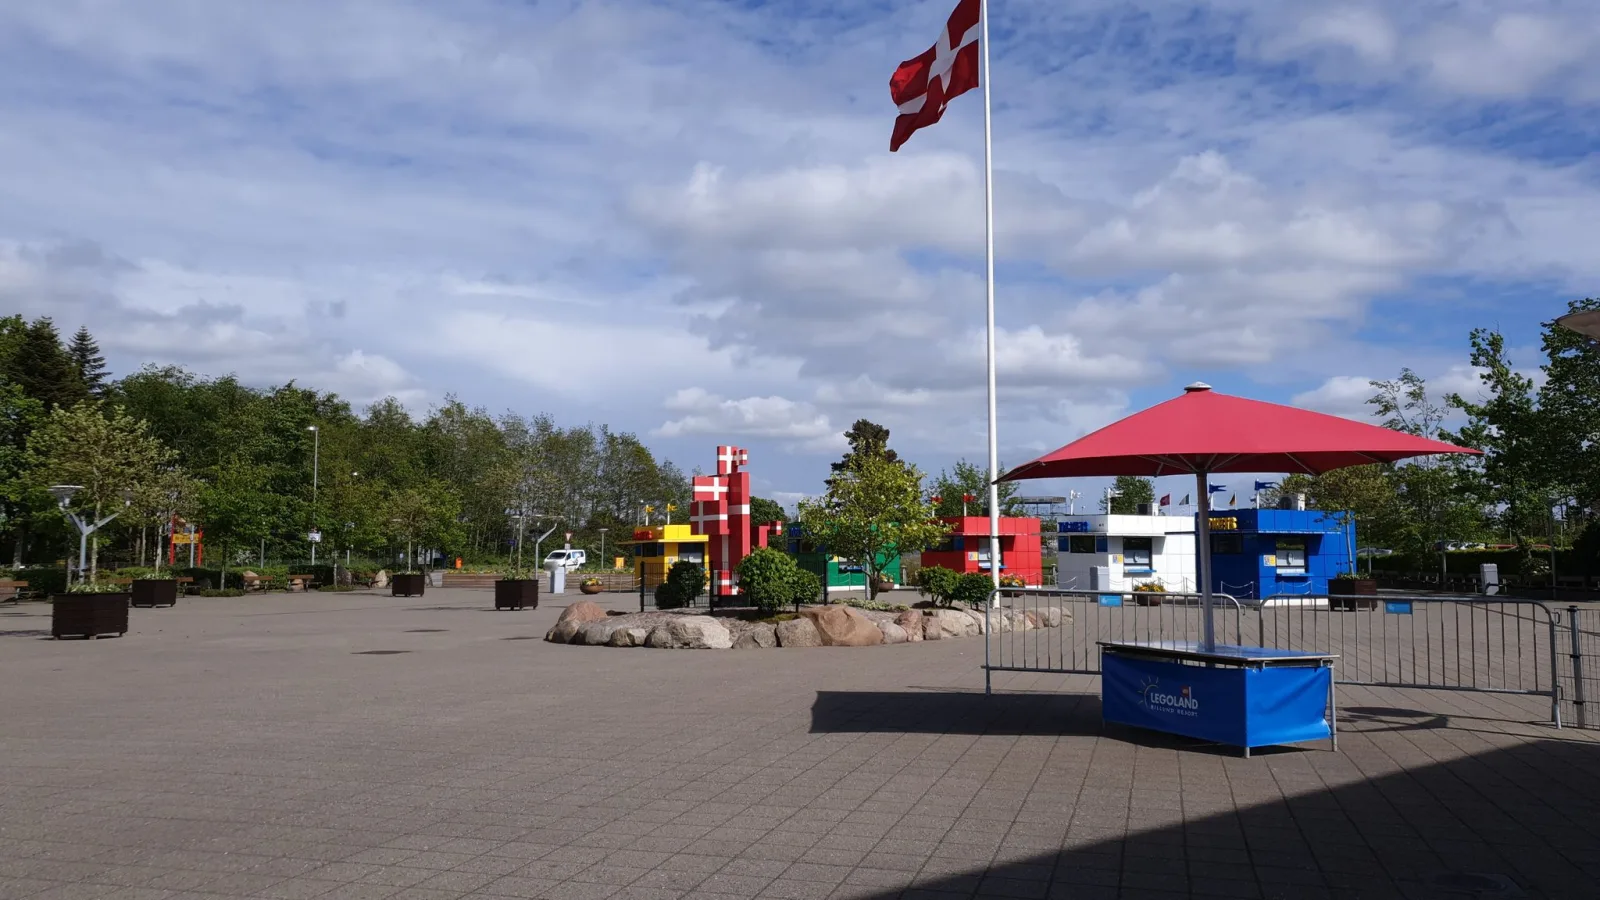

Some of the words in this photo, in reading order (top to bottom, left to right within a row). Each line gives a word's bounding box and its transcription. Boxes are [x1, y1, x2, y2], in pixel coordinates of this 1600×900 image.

[1150, 692, 1198, 709] LEGOLAND
[1150, 704, 1174, 712] BILLUND
[1177, 709, 1198, 717] RESORT
